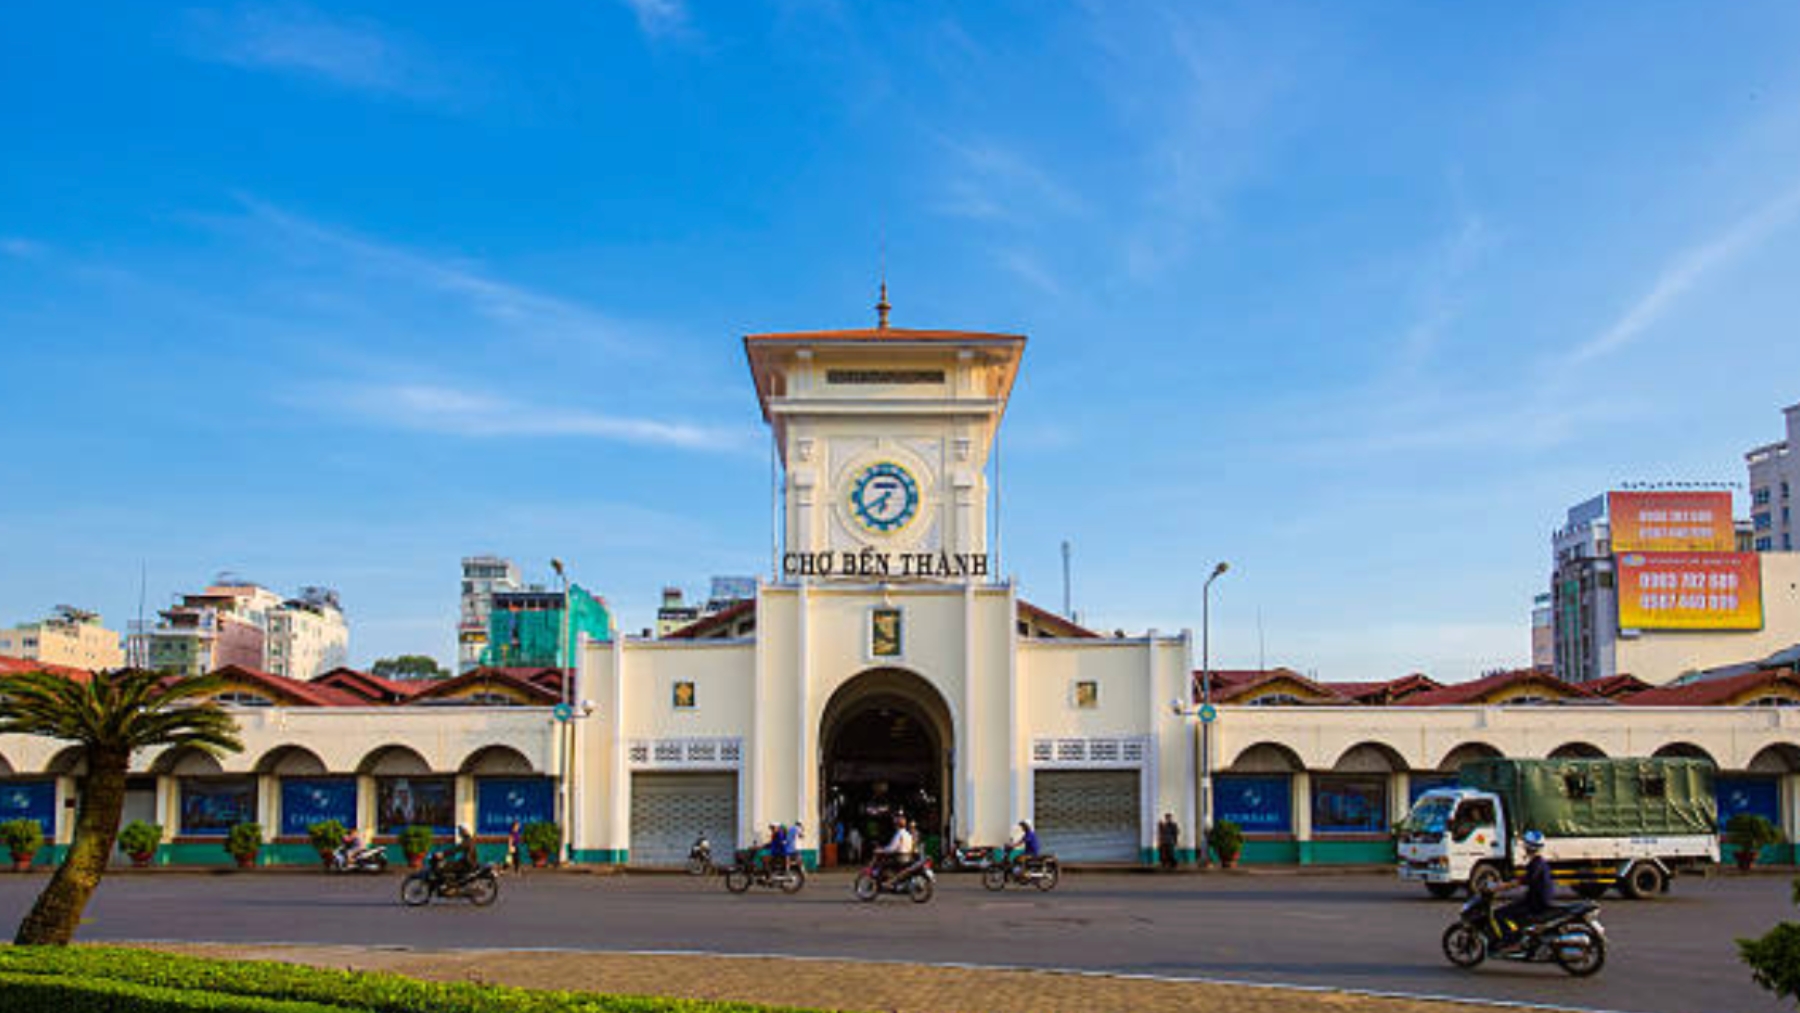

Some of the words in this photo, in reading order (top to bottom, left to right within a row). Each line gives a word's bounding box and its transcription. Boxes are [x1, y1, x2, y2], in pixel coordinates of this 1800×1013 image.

[783, 549, 834, 578] CHỢ
[842, 545, 890, 576] BẾN
[899, 546, 987, 577] THÀNH
